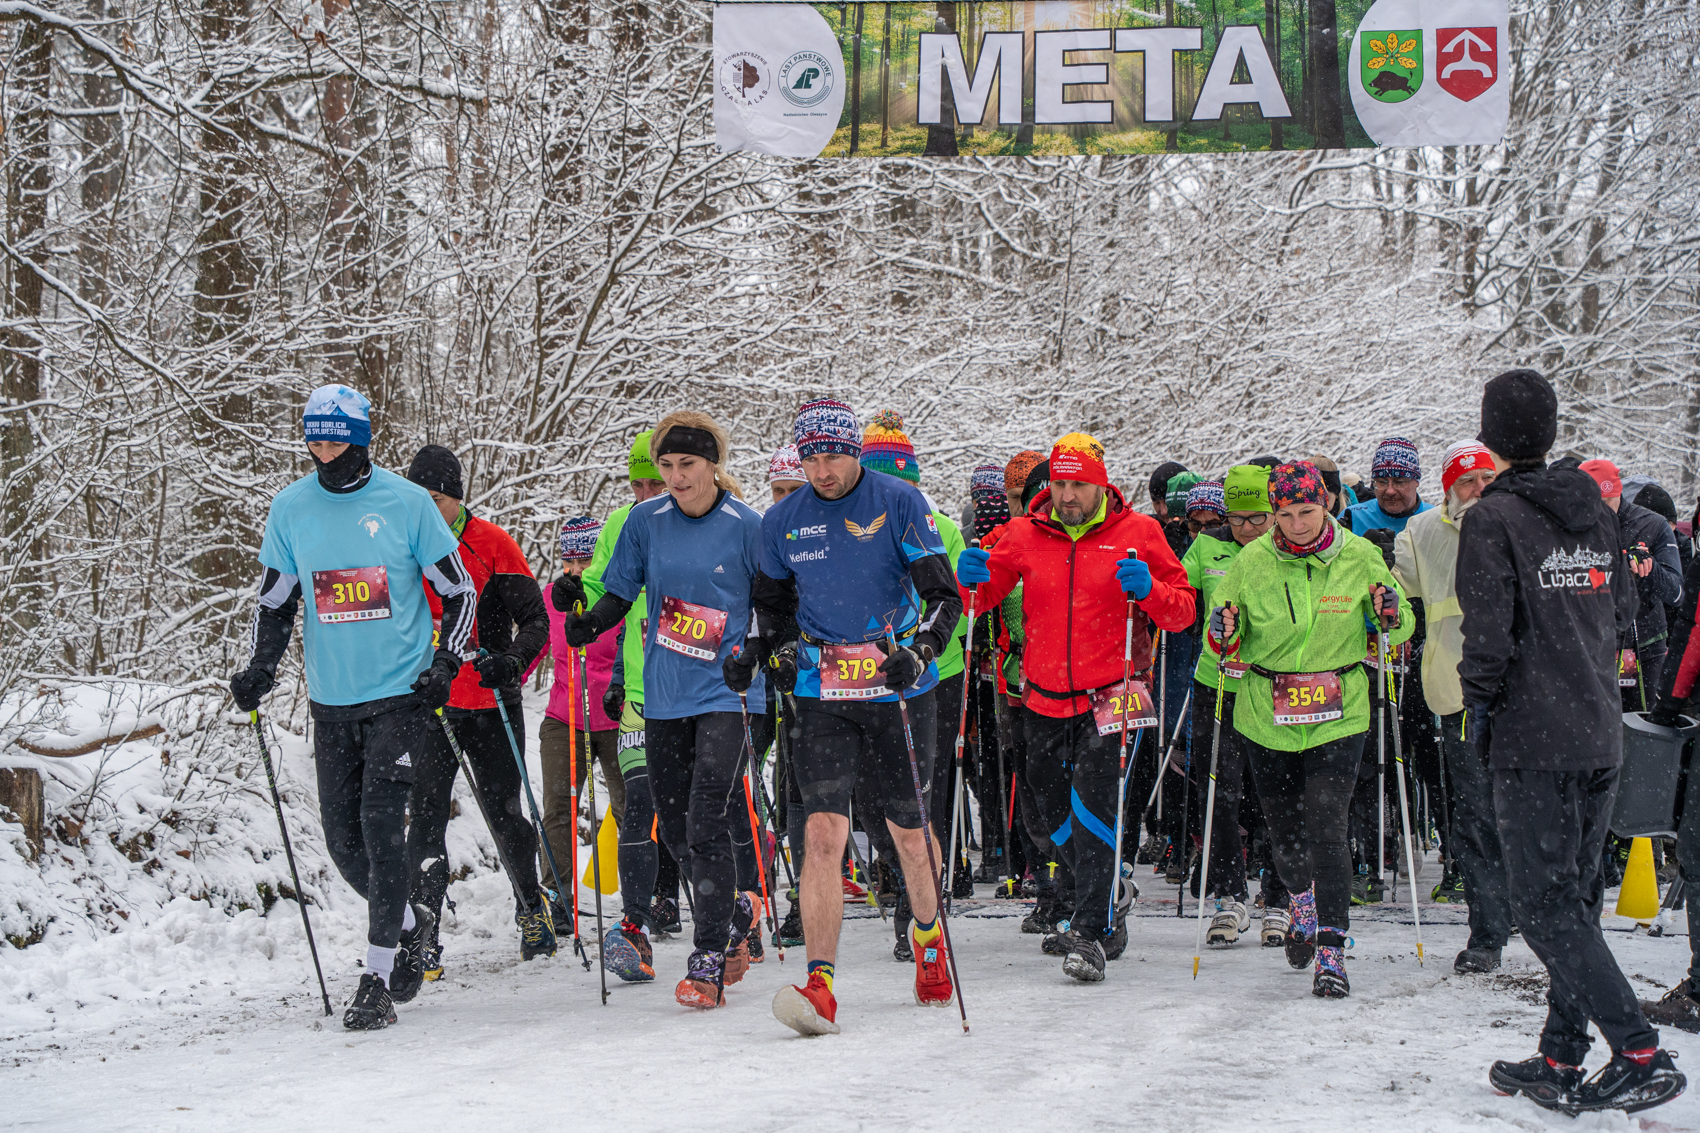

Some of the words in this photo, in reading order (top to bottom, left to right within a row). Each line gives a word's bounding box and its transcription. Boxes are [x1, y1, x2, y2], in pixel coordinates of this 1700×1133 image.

[722, 51, 768, 66] STOWARZYSZENIE
[780, 59, 793, 78] LASY
[917, 25, 1292, 125] META
[1227, 485, 1261, 499] Spring
[332, 581, 370, 604] 310
[671, 611, 707, 640] 270
[1369, 641, 1399, 660] 34
[837, 657, 877, 681] 379
[1109, 692, 1142, 716] 221
[1287, 685, 1327, 707] 354
[586, 762, 594, 802] CARBON
[910, 761, 932, 844] PACEMAKER
